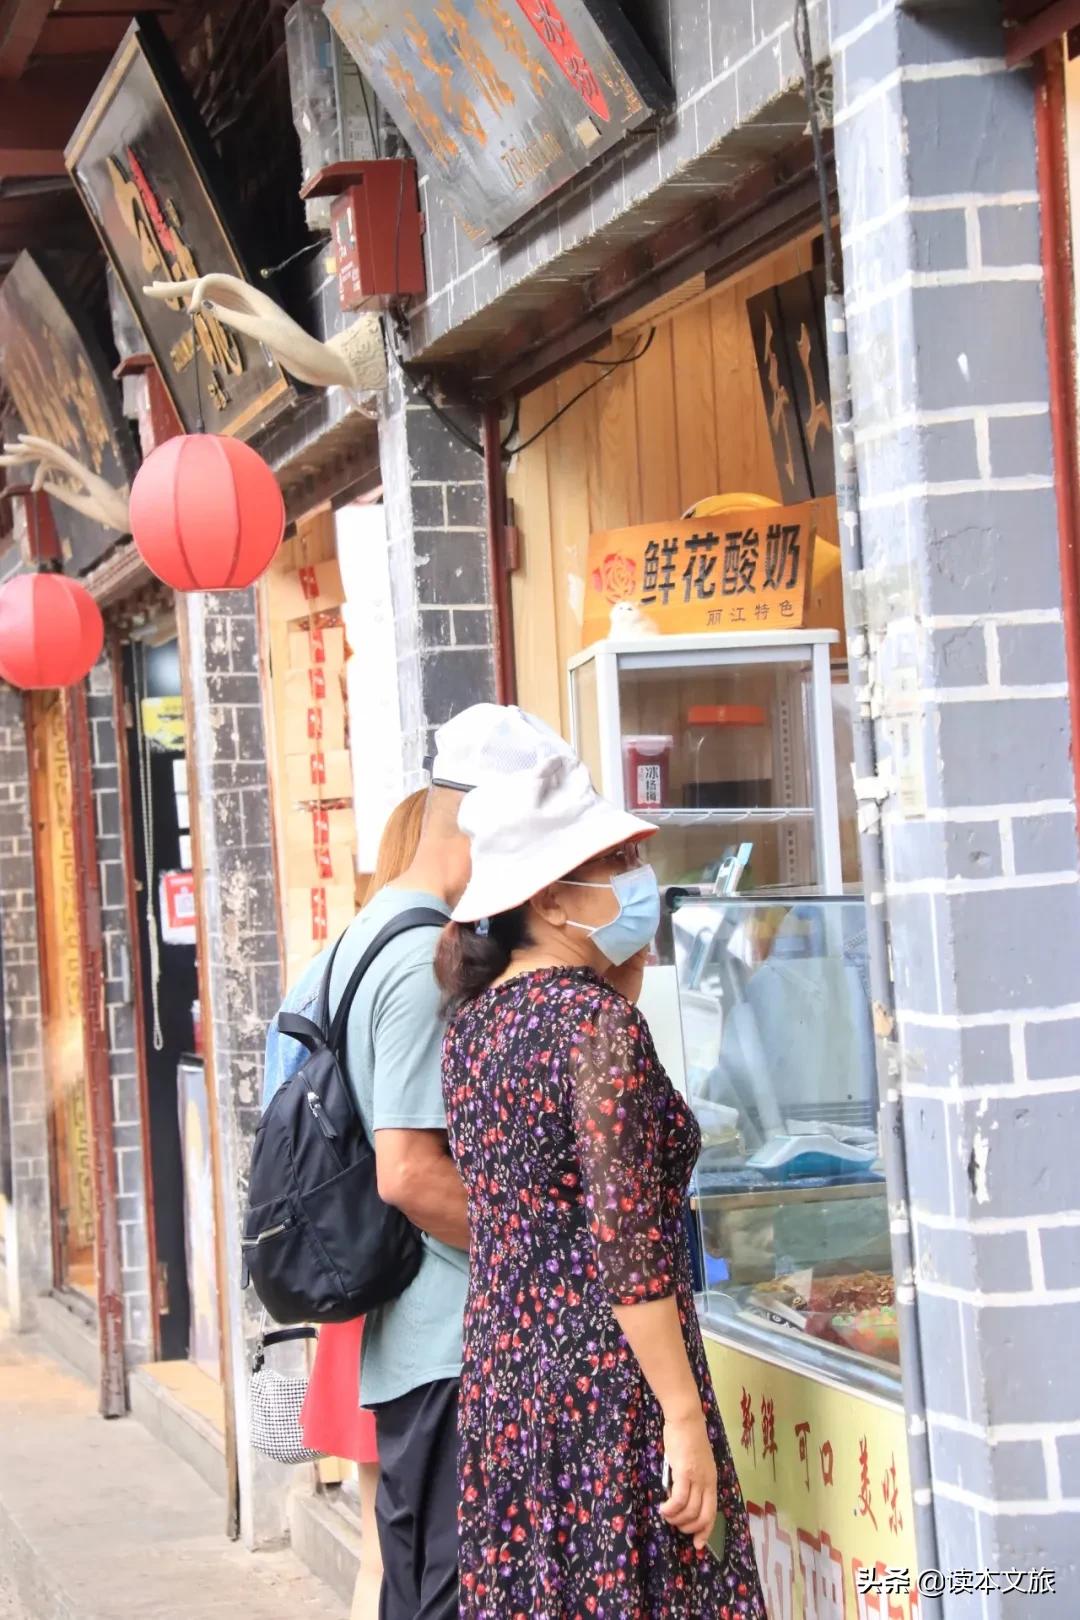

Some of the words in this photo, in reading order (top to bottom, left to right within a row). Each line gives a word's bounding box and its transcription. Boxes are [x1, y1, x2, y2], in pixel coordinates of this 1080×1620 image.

[640, 523, 801, 606] 鲜花酸奶
[706, 600, 795, 627] 丽江特色
[740, 1386, 778, 1482] 新鲜
[795, 1421, 834, 1493] 可口
[858, 1434, 904, 1536] 美味
